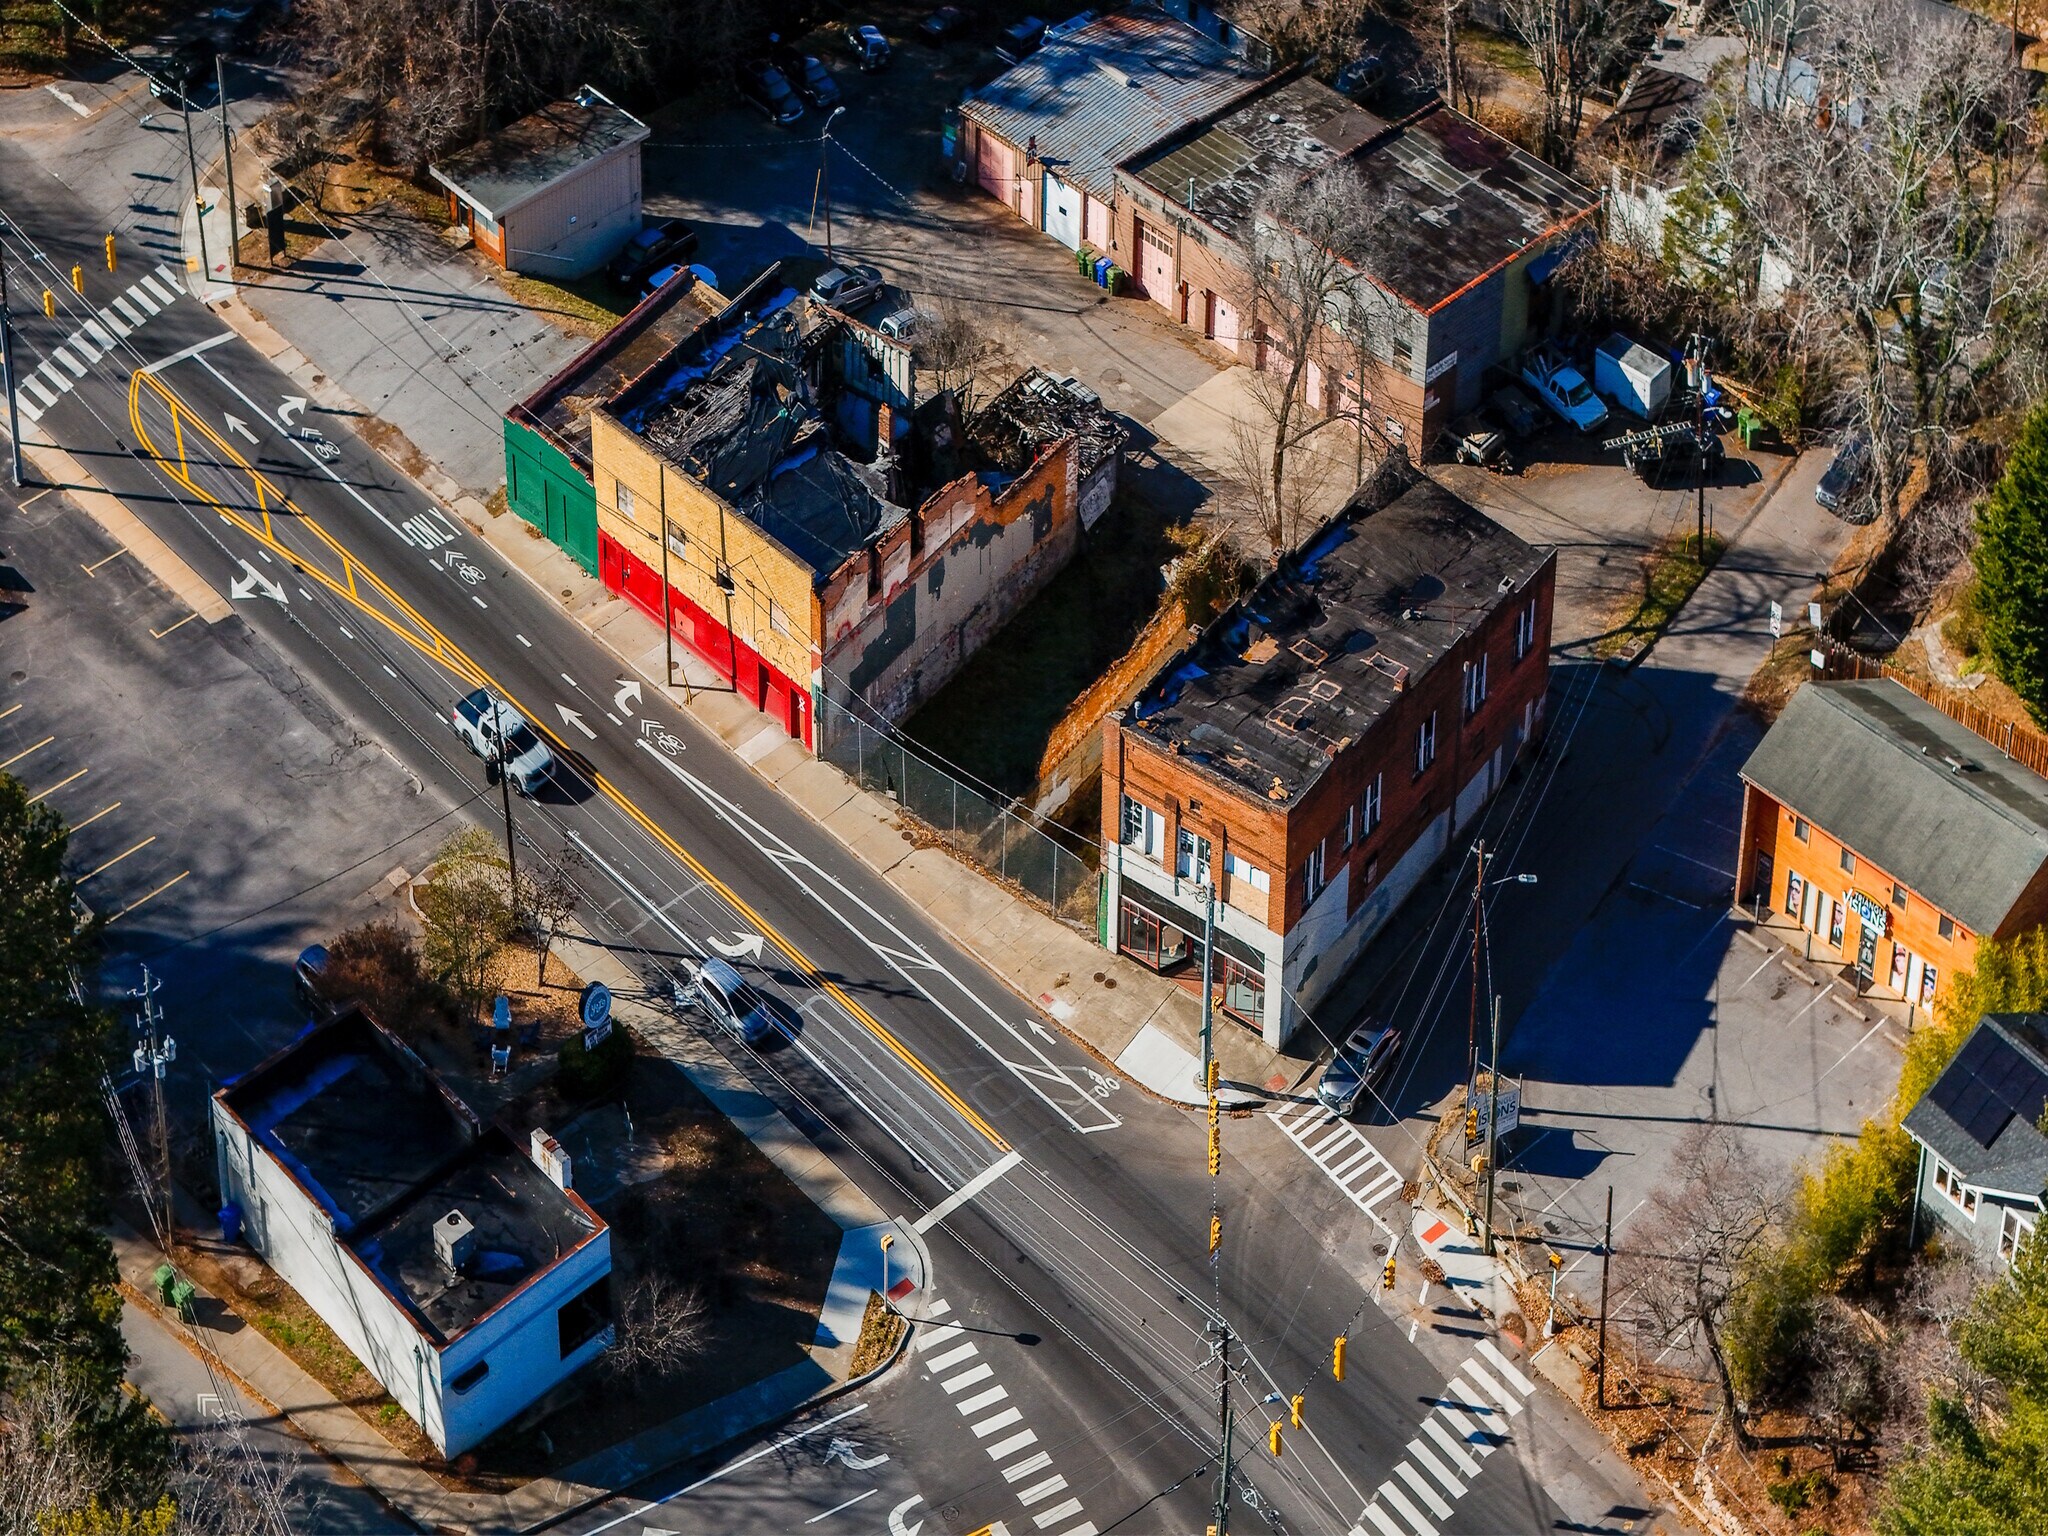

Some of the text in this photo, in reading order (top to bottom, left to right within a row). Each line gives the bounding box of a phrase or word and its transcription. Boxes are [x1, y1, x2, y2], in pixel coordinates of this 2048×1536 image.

[402, 506, 463, 550] ONLY
[1842, 888, 1887, 931] VISIONS
[1854, 891, 1887, 918] TRIANGLE
